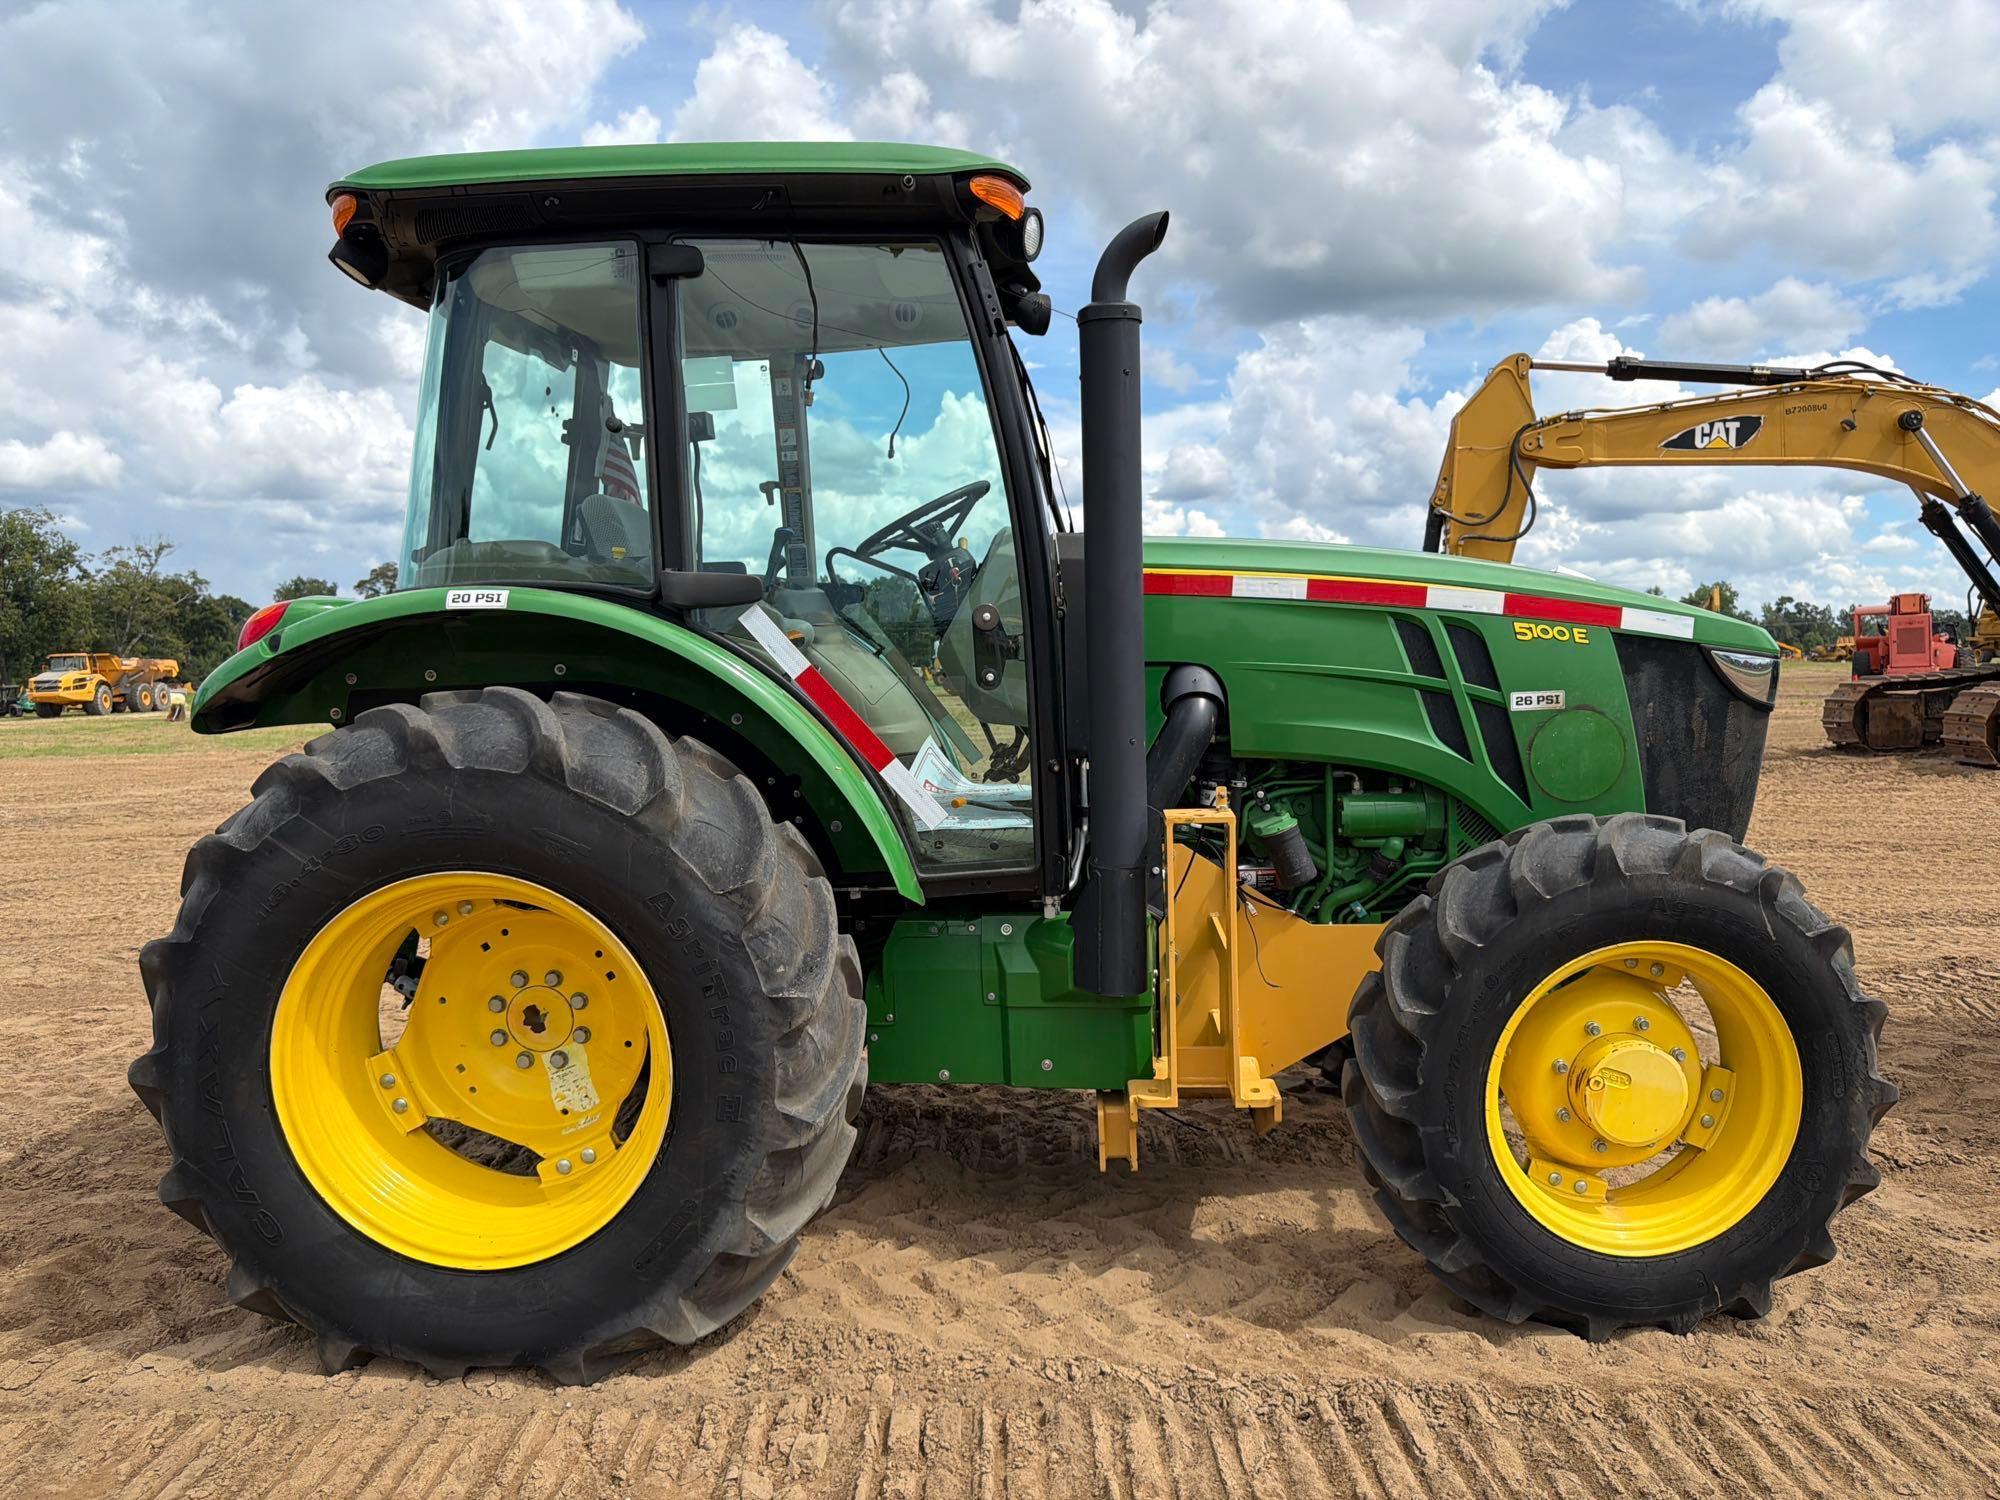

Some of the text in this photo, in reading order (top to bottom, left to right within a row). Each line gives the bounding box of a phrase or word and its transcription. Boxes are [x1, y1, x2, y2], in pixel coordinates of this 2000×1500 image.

[1694, 421, 1741, 449] CAT
[451, 593, 502, 603] 20 PSI
[1513, 621, 1590, 644] 5100 E
[1515, 695, 1561, 706] 26 PSI
[200, 961, 286, 1247] GALAXY
